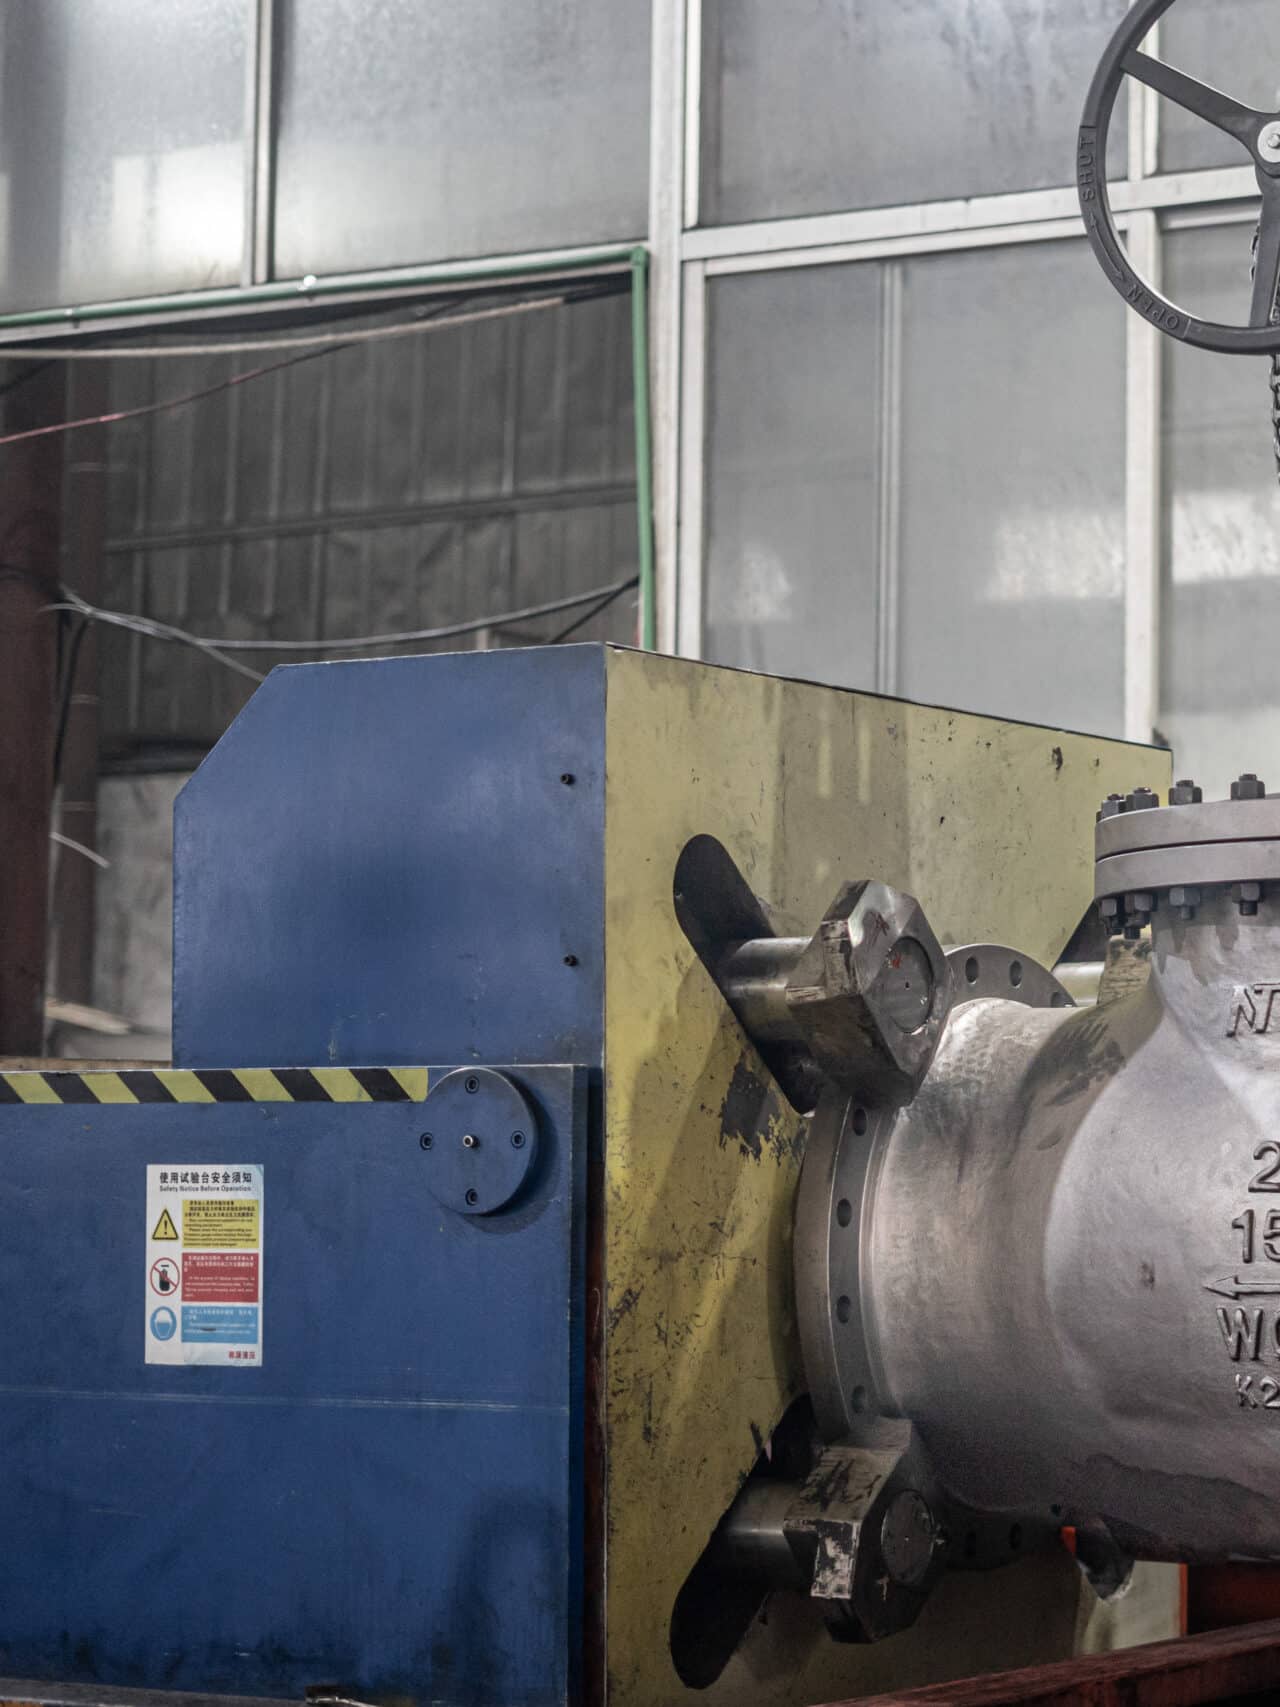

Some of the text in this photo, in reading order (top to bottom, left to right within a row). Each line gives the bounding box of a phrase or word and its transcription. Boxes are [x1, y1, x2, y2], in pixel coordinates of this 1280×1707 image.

[1079, 136, 1096, 202] SHUT
[1126, 284, 1180, 330] OPEN
[159, 1172, 252, 1184] 使用试验台安全须知
